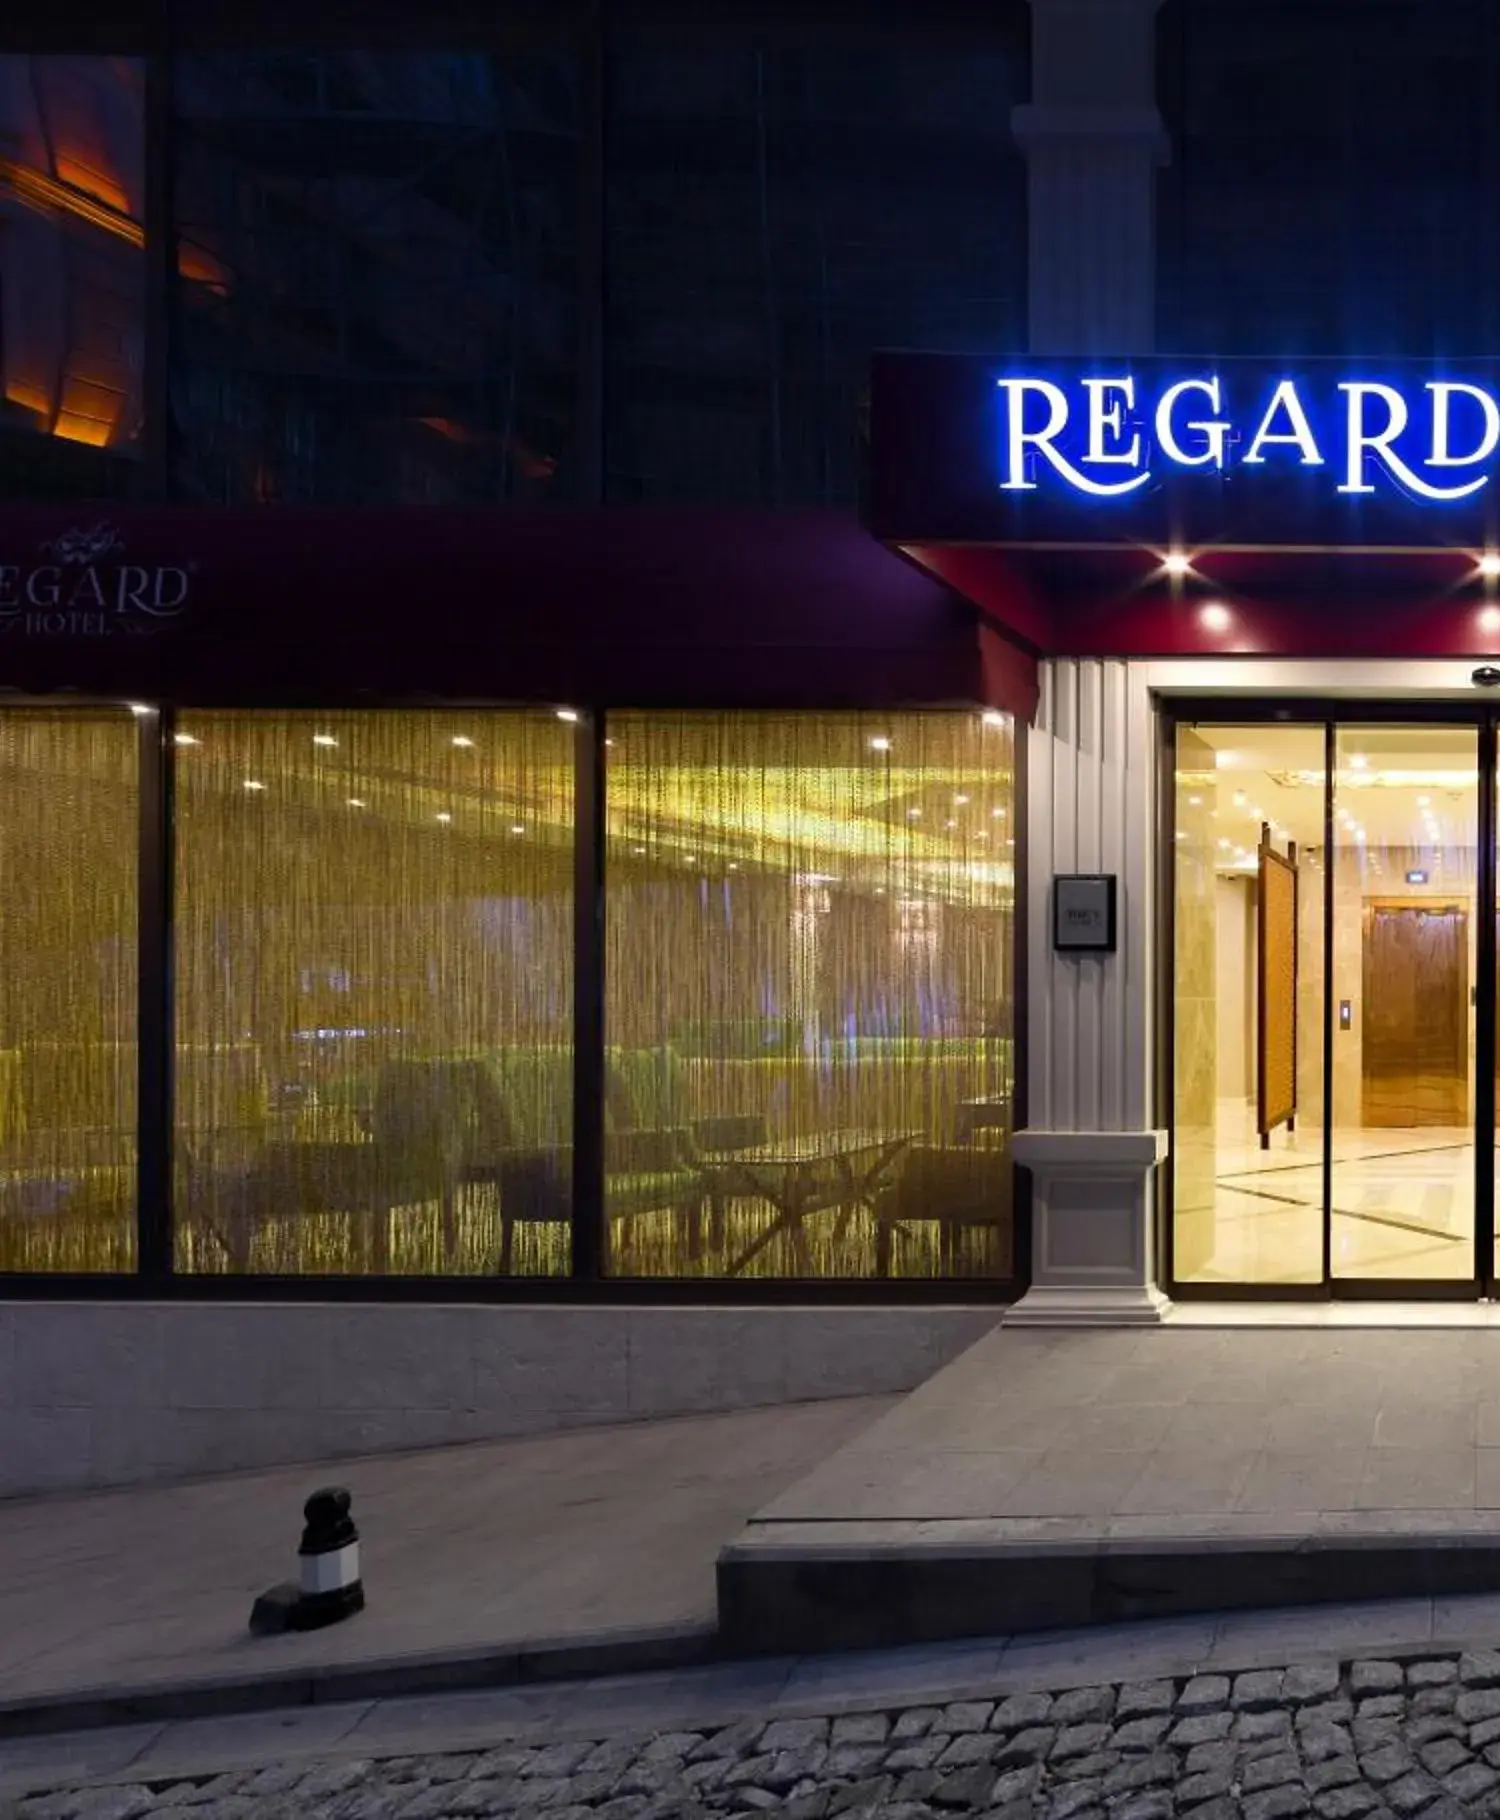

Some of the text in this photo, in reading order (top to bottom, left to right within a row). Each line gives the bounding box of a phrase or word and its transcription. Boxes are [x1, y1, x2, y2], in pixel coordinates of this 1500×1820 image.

[997, 376, 1500, 498] REGARD
[0, 565, 189, 617] EGARD
[25, 611, 113, 637] HOTEL
